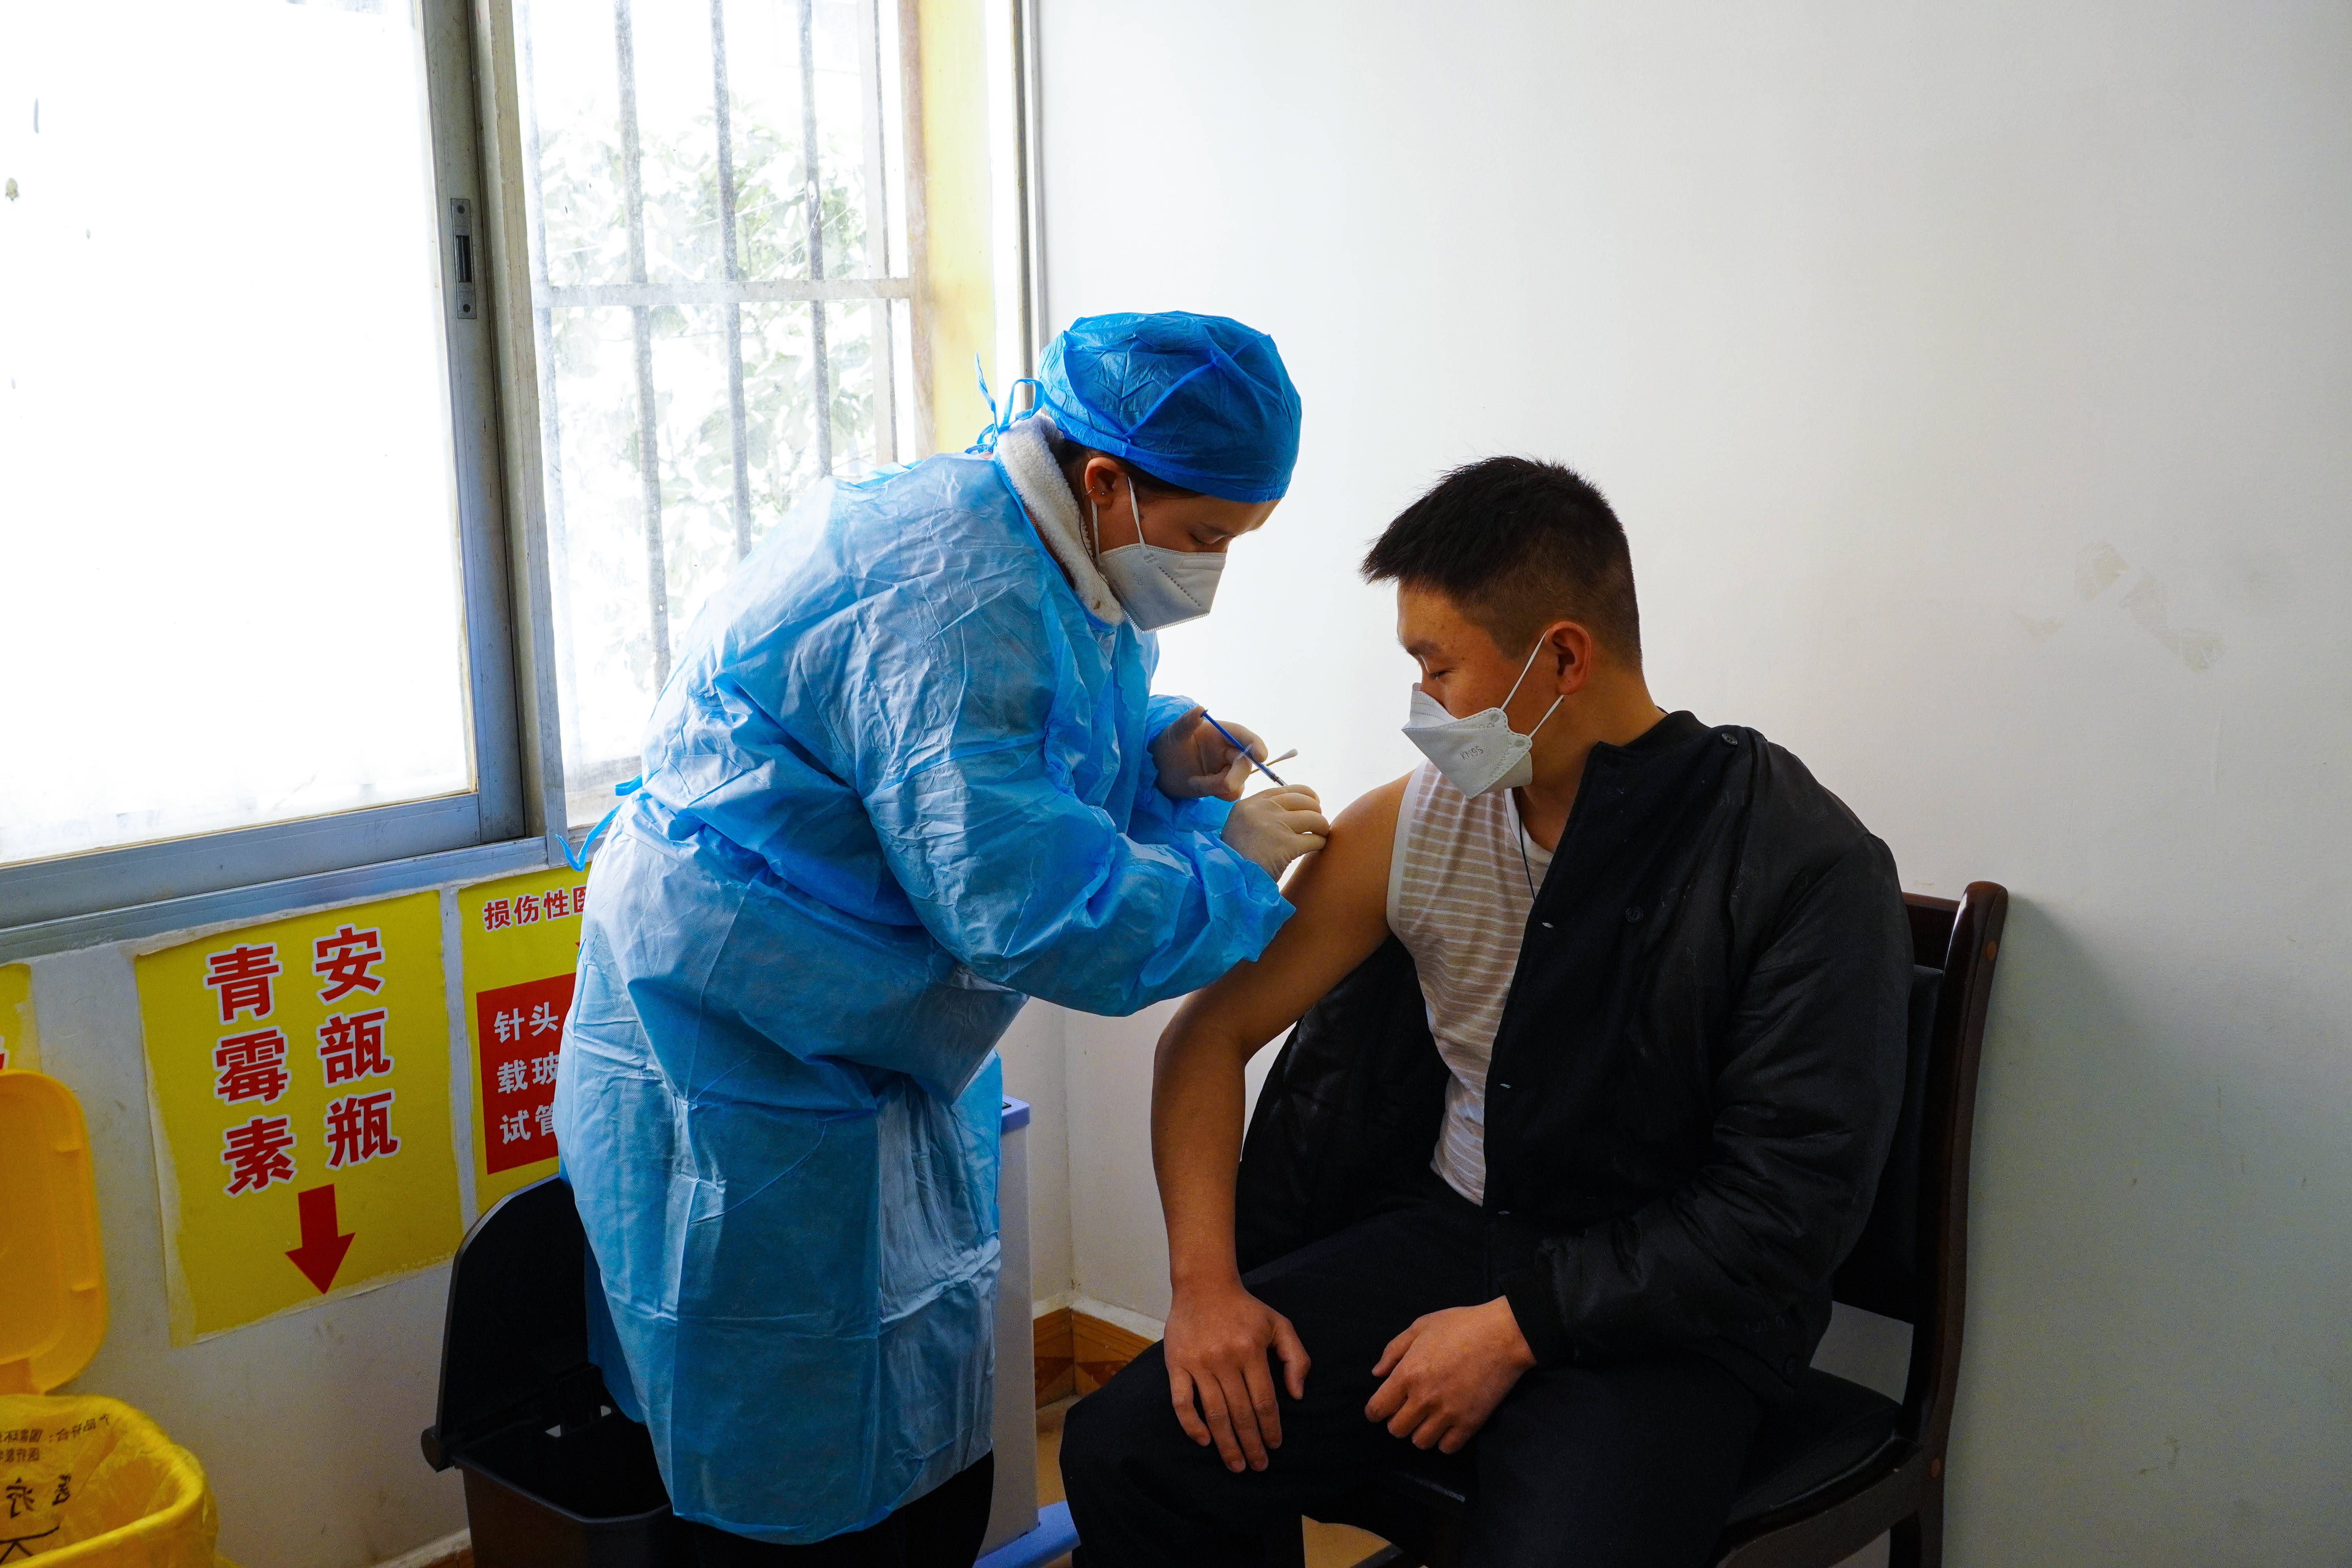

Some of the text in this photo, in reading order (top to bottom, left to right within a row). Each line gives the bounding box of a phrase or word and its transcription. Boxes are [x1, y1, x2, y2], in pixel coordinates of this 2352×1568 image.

[1460, 746, 1484, 760] KN95
[493, 1001, 559, 1044] 针头
[314, 926, 399, 1168] 安瓿瓶
[206, 945, 296, 1196] 青霉素
[497, 1051, 560, 1094] 载玻
